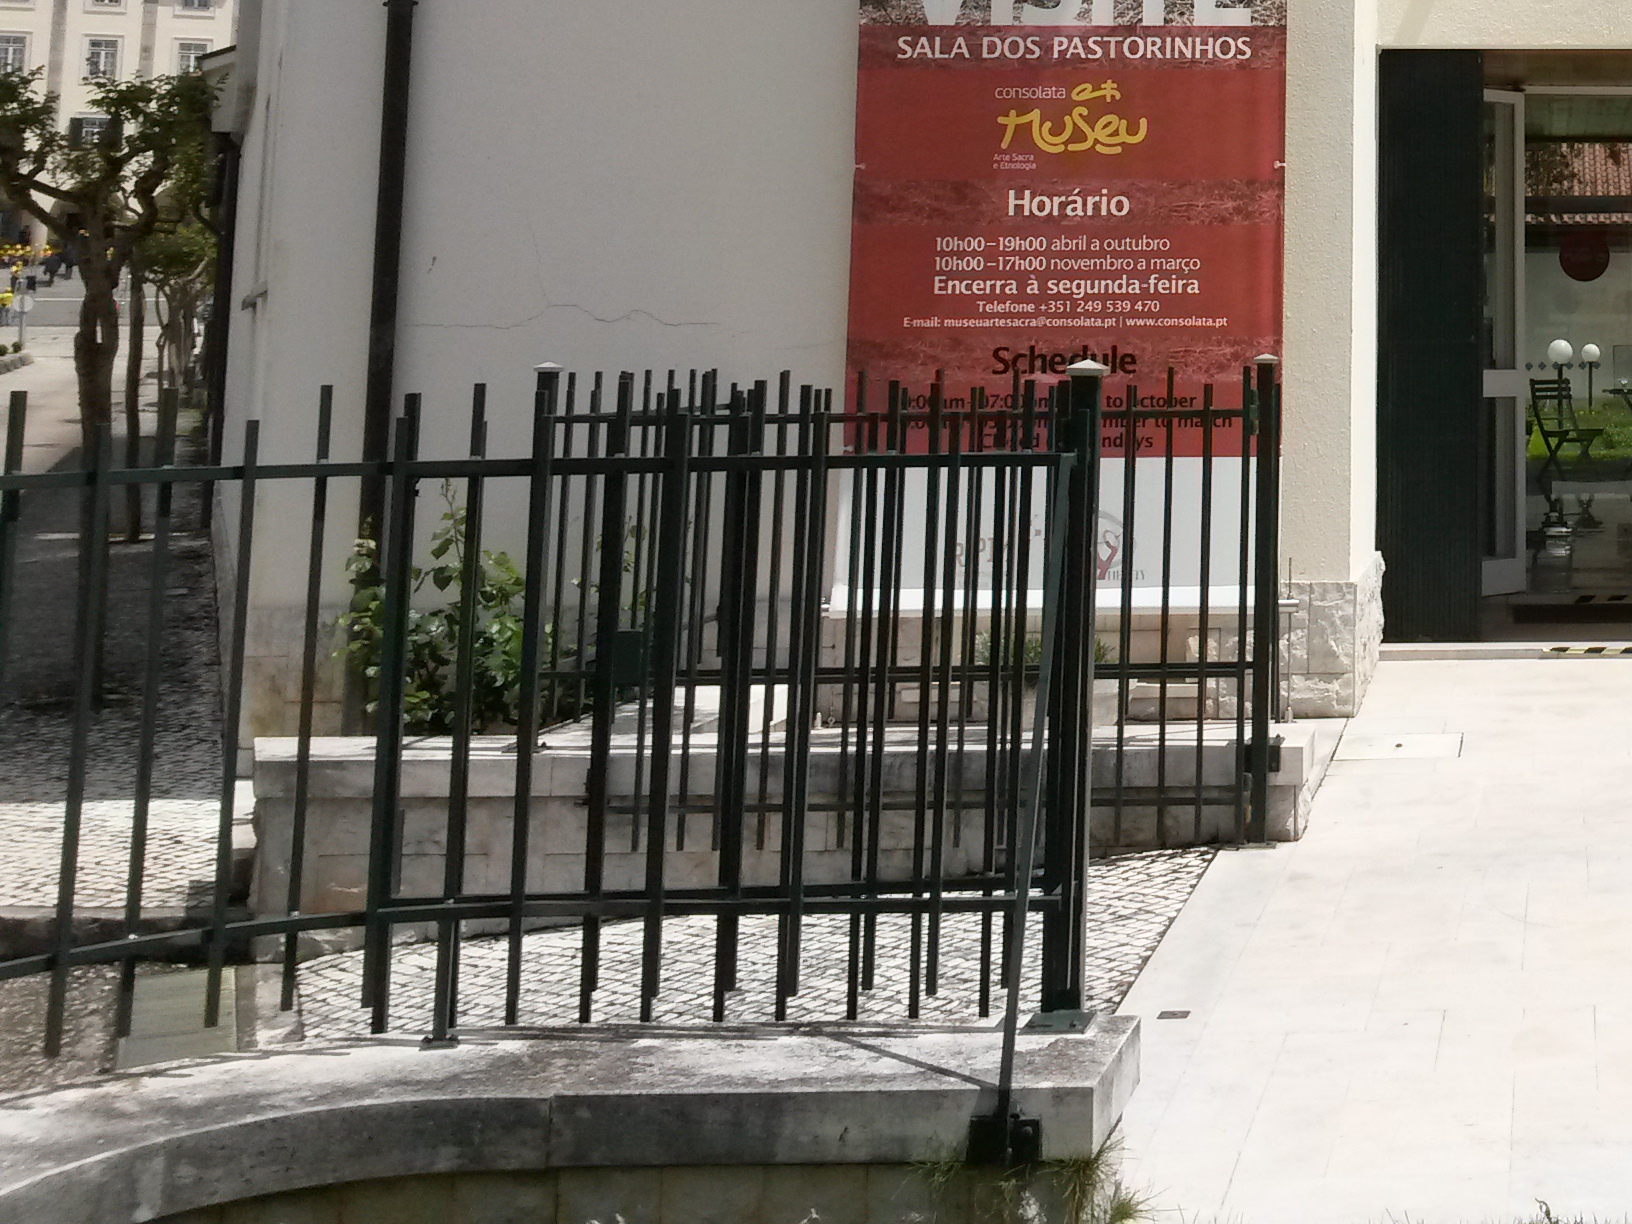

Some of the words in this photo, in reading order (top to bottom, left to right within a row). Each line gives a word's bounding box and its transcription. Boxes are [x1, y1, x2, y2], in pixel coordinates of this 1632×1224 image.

[897, 36, 970, 59] SALA
[982, 36, 1040, 59] DOS
[1053, 36, 1252, 59] PASTORINHOS
[995, 85, 1066, 100] consolata
[993, 153, 1010, 162] Arte
[1011, 153, 1035, 162] Sacra
[1000, 162, 1037, 171] Etnologia
[1007, 188, 1130, 217] Horário
[1050, 235, 1087, 251] abril
[1090, 240, 1100, 251] a
[1103, 236, 1170, 251] outubro
[1050, 255, 1133, 271] novembro
[1137, 260, 1147, 271] a
[1150, 260, 1201, 276] março
[933, 276, 1017, 295] Encerra
[1026, 274, 1039, 294] à
[1047, 275, 1200, 298] segunda-feira
[977, 300, 1035, 313] Telefone
[1039, 301, 1071, 313] +351
[1076, 301, 1101, 313] 249
[1106, 301, 1131, 313] 539
[1134, 301, 1160, 313] 470
[903, 316, 941, 328] E-mail:
[943, 316, 1117, 329] museuartesacra@consolata.pt
[1126, 315, 1228, 328] www.consolata.pt
[1105, 395, 1123, 408] to
